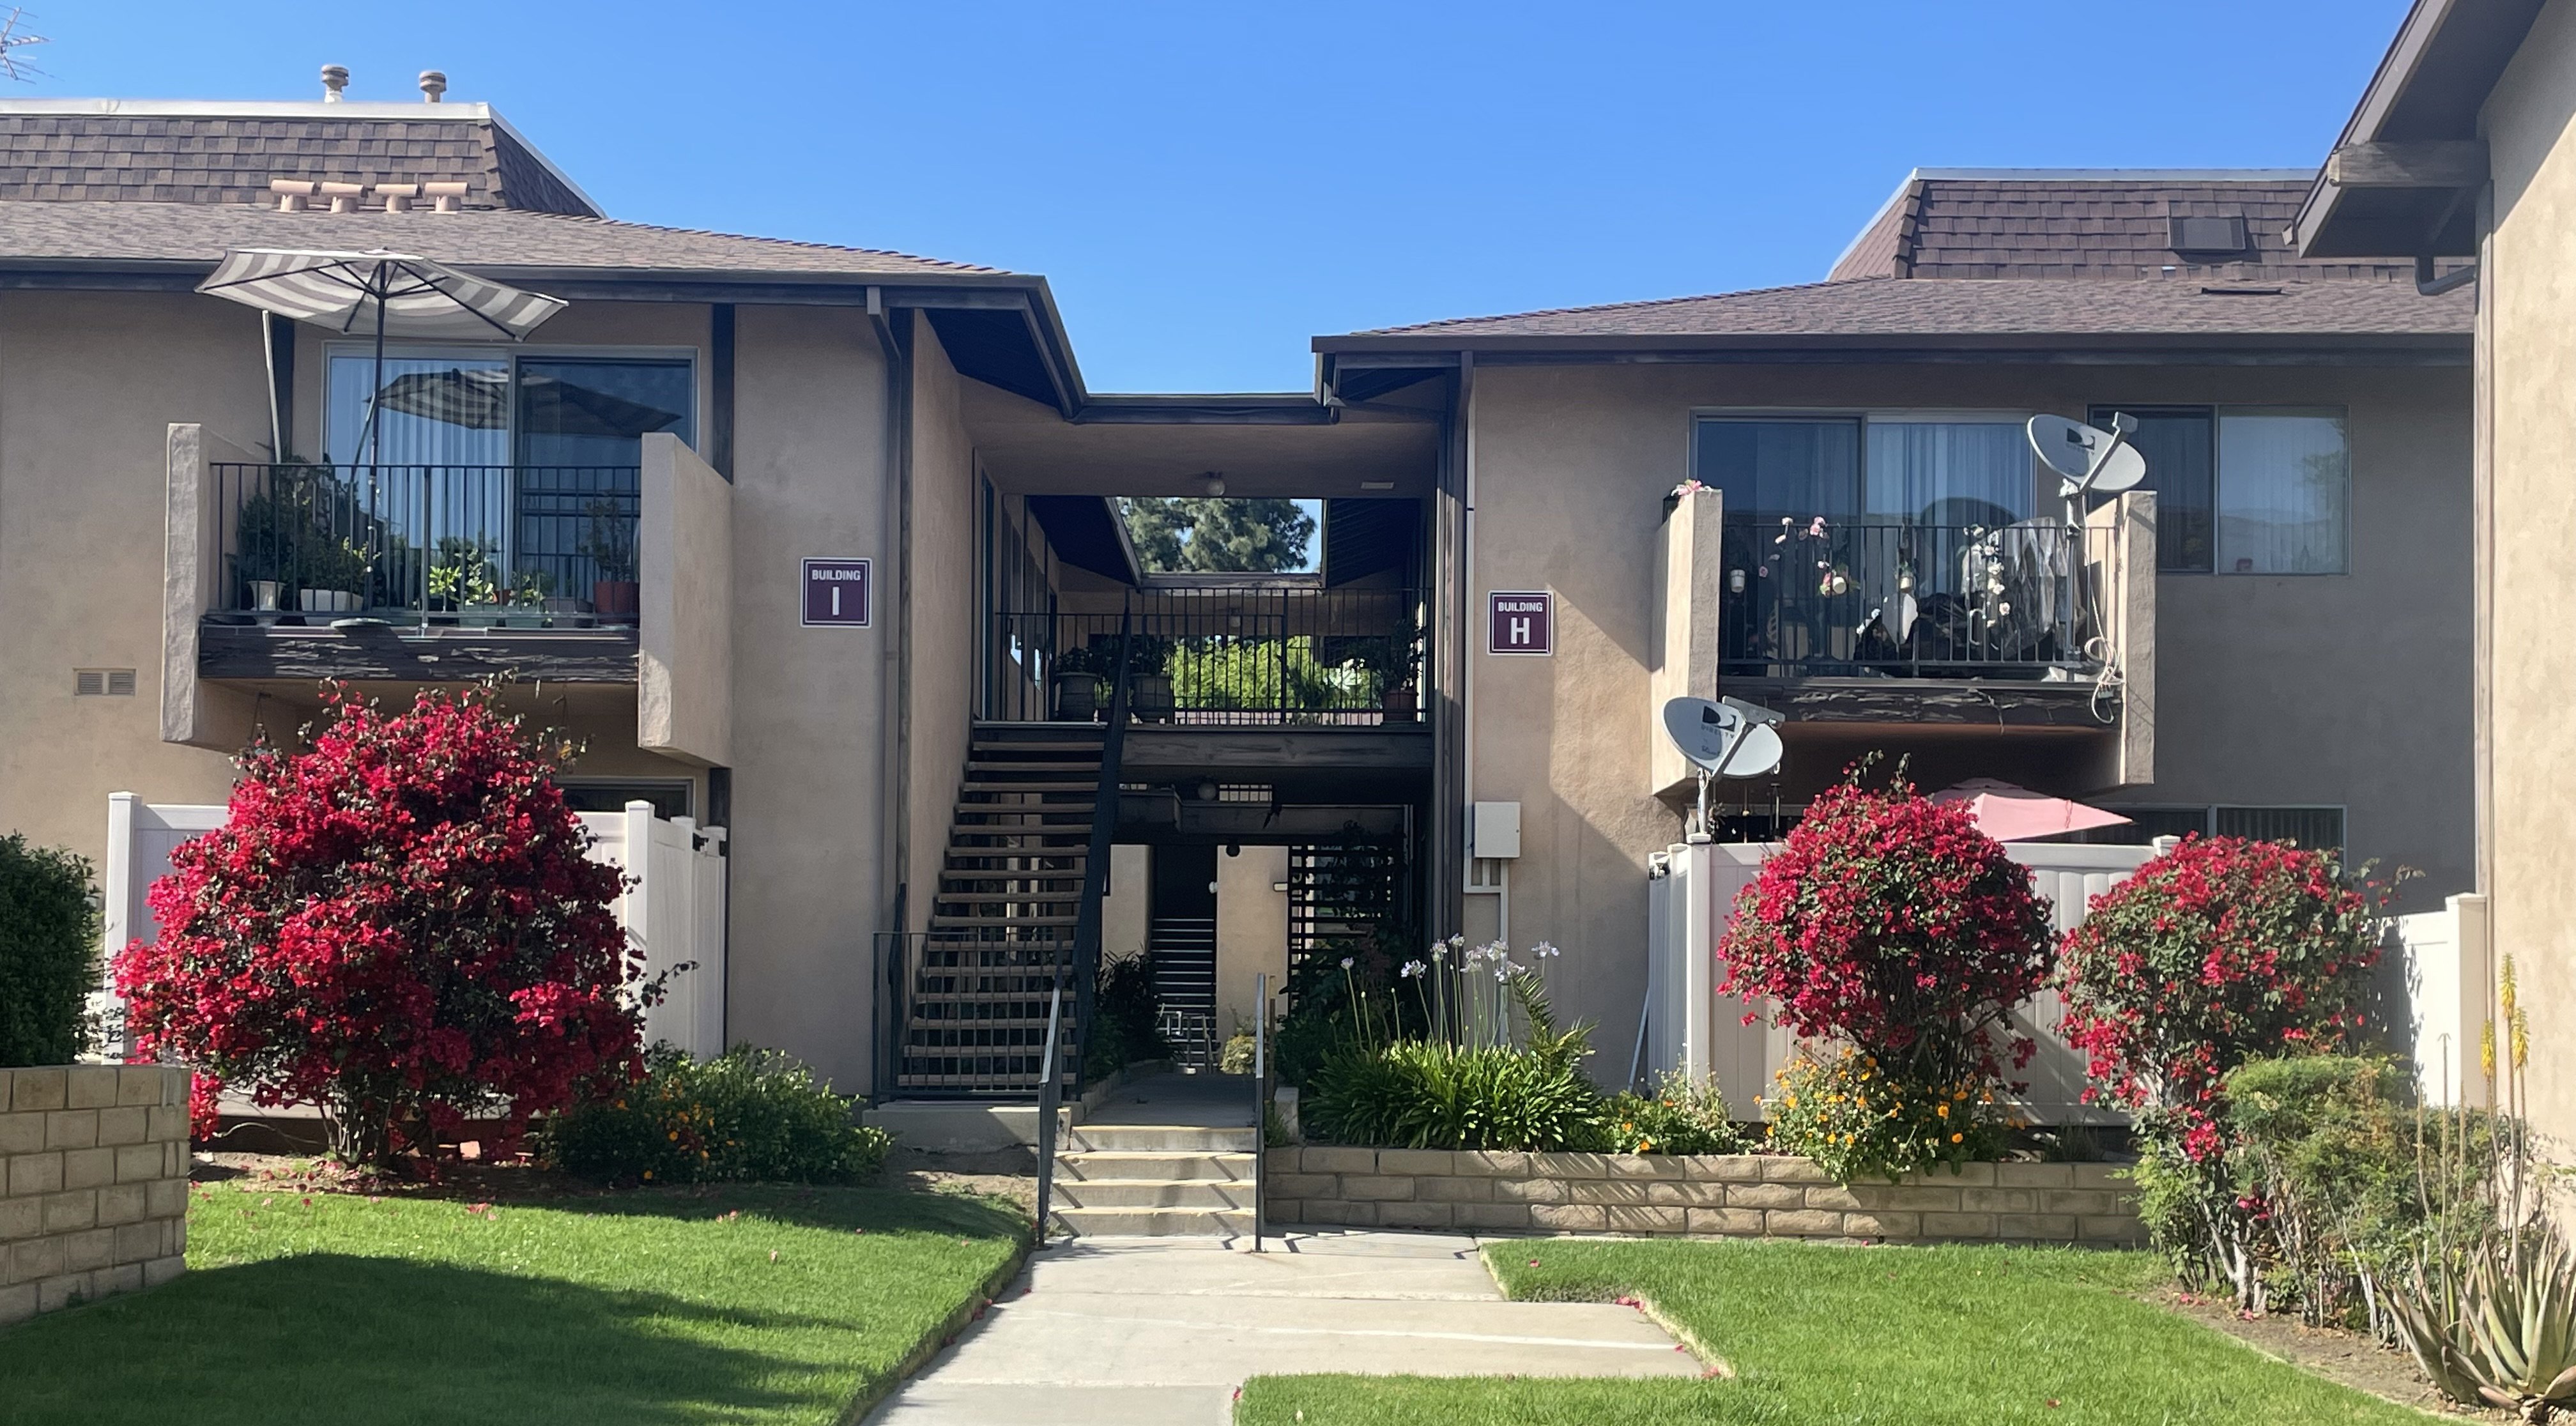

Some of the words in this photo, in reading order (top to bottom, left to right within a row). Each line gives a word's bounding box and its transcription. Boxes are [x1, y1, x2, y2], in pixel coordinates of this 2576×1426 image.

[811, 569, 861, 581] BUILDING
[832, 586, 839, 616] I
[1498, 602, 1543, 612] BUILDING
[1510, 617, 1529, 644] H
